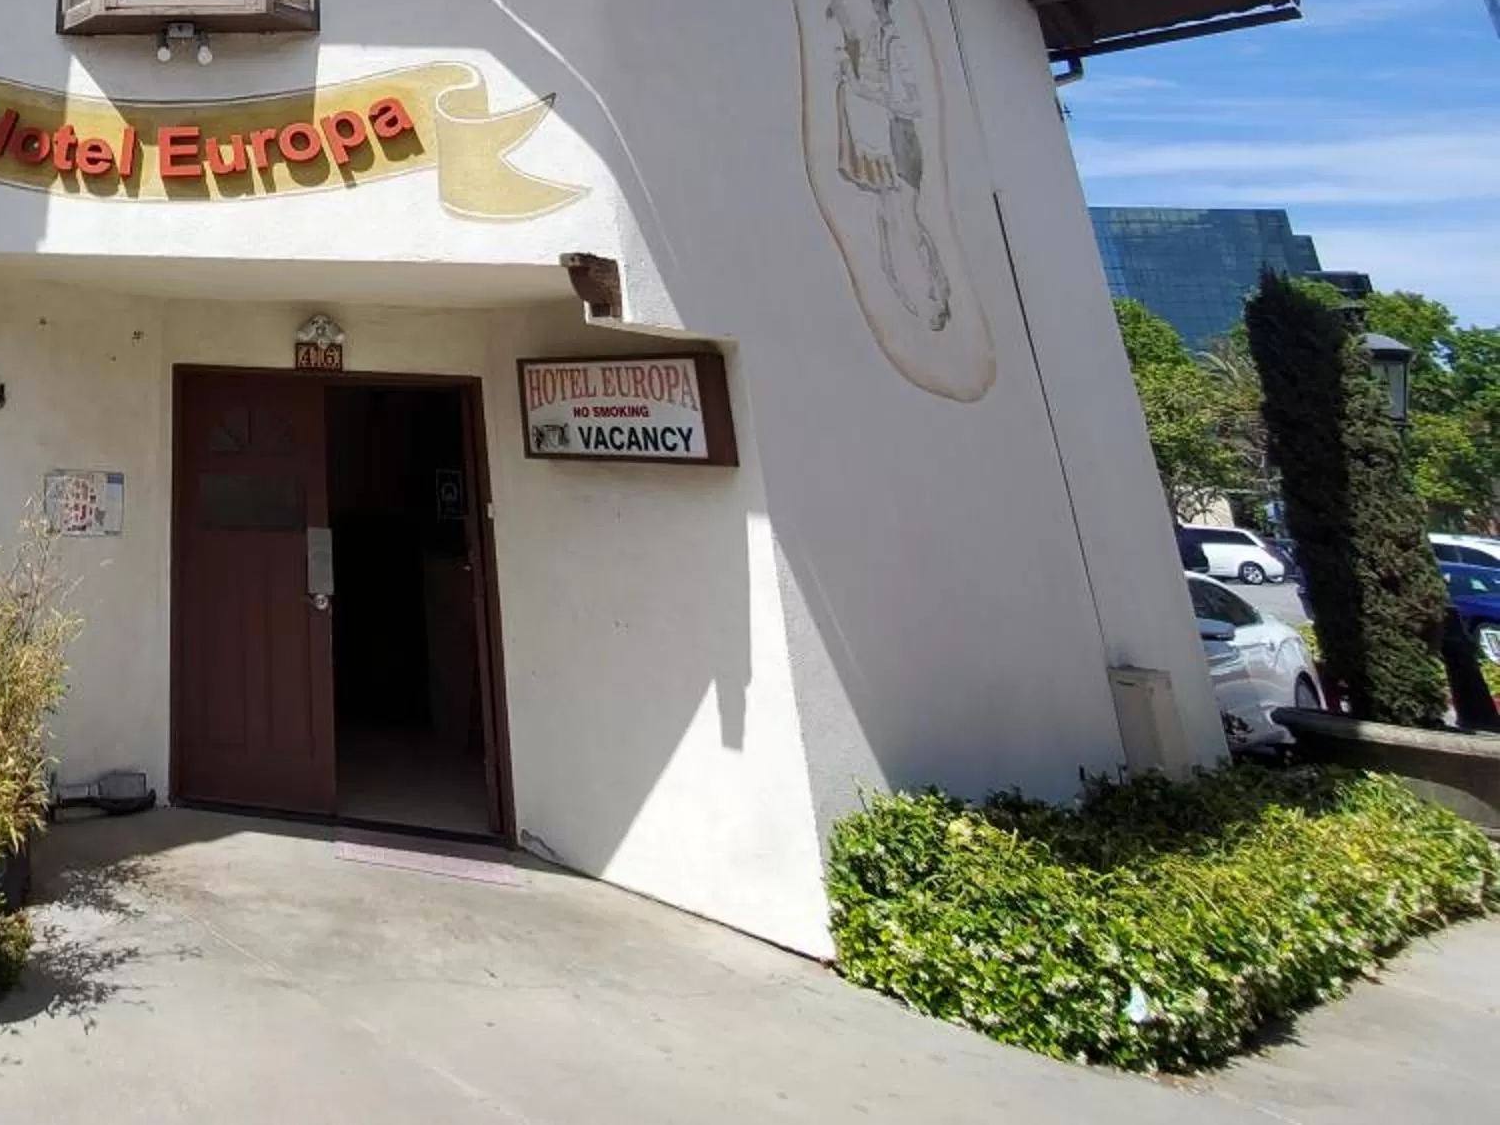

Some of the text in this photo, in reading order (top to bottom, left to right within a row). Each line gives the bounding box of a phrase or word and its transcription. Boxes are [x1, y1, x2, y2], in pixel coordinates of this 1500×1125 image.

[156, 95, 415, 179] Europa
[527, 363, 699, 412] HOTEL EUROPA
[573, 406, 650, 418] NO SMOKING
[578, 426, 694, 453] VACANCY
